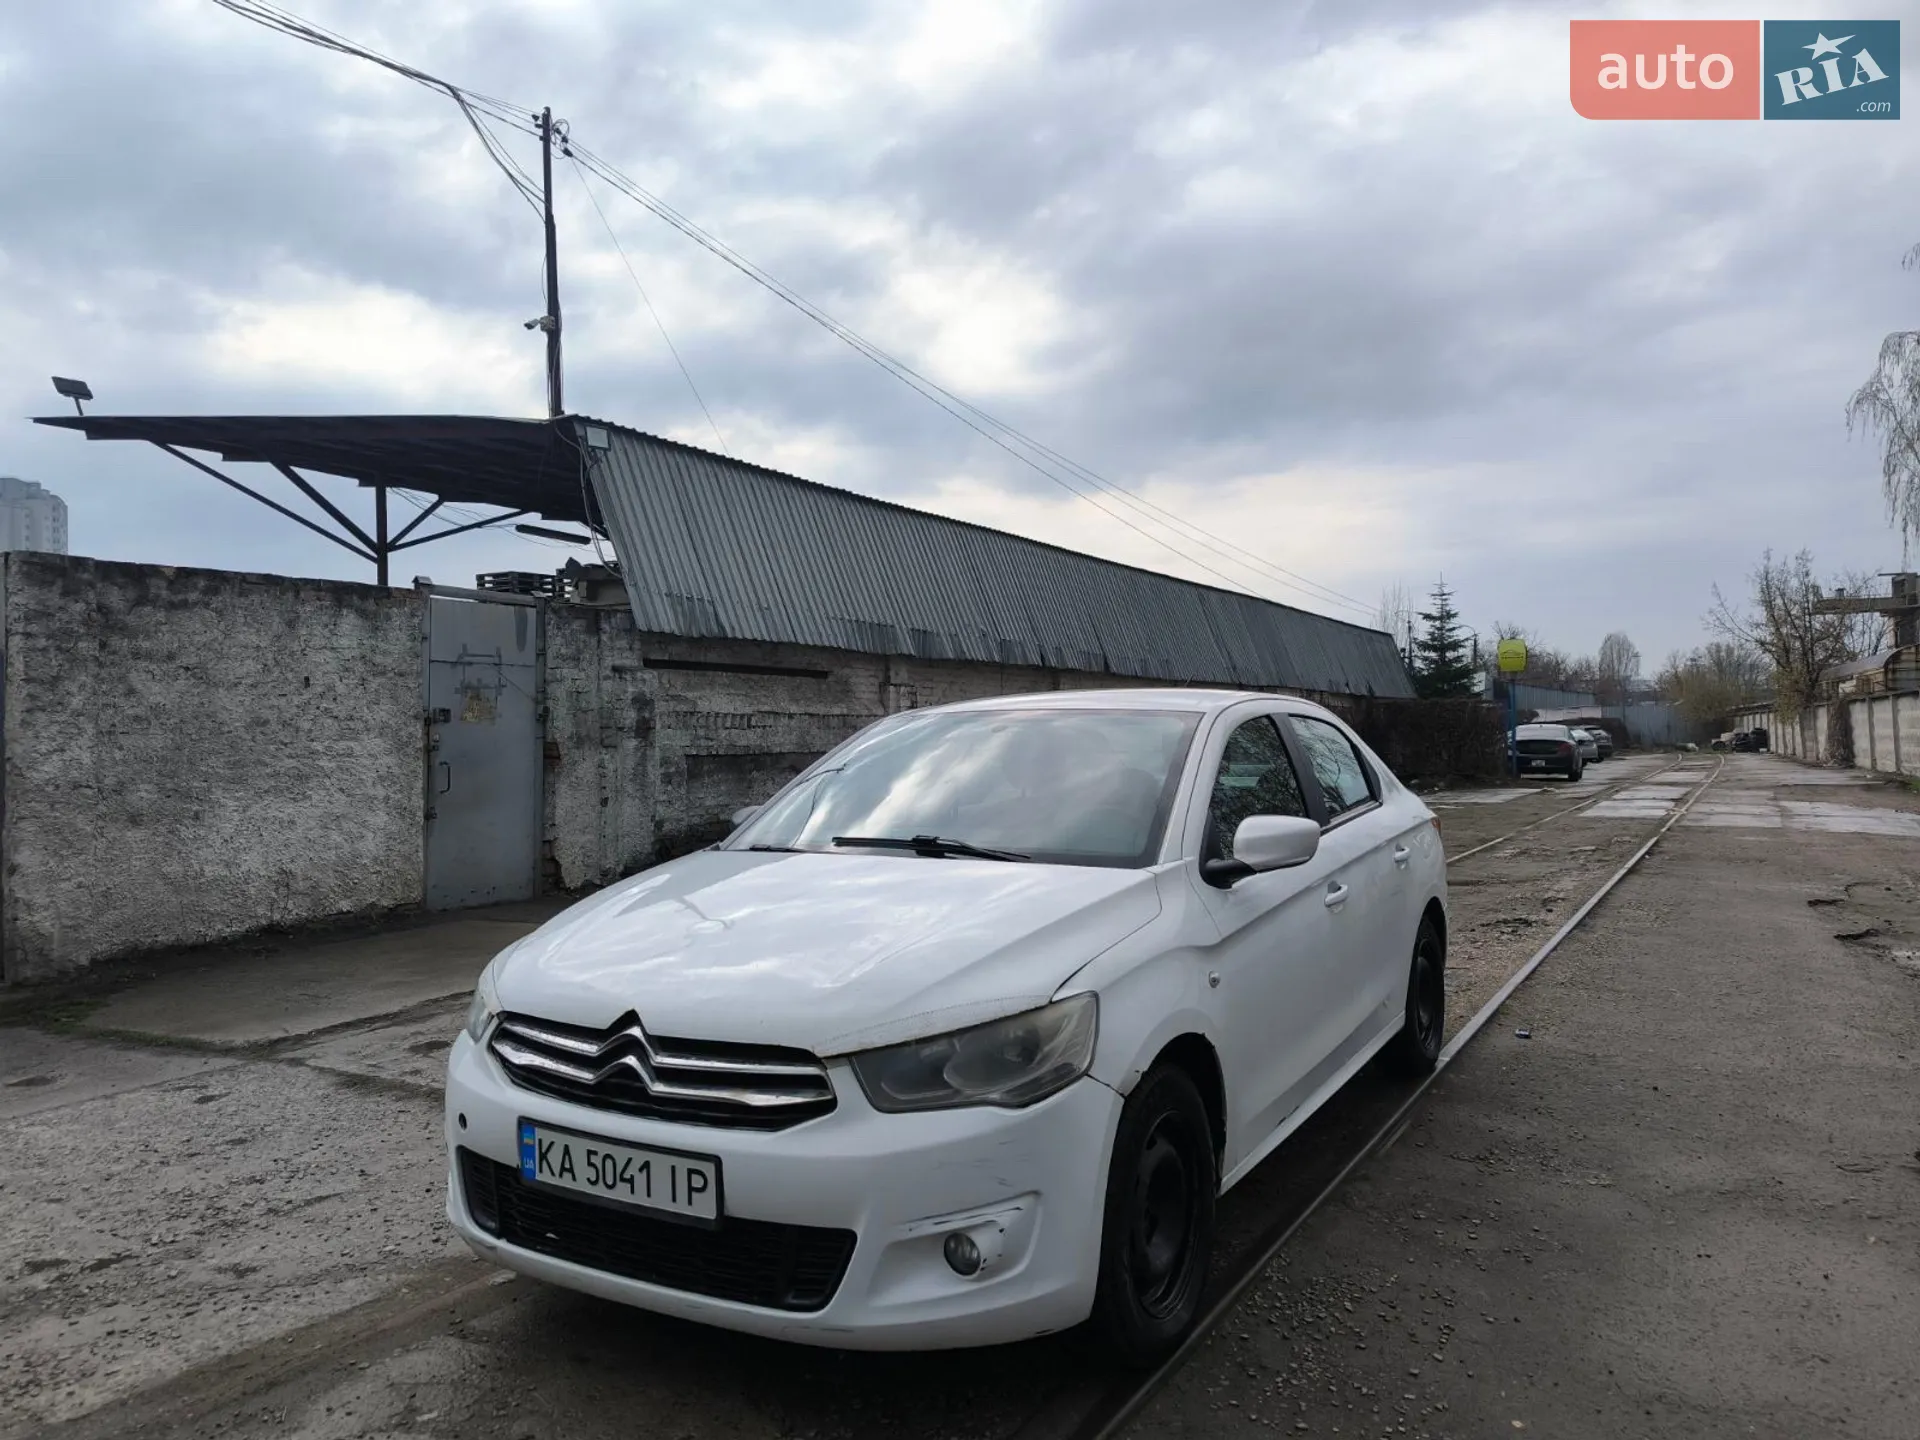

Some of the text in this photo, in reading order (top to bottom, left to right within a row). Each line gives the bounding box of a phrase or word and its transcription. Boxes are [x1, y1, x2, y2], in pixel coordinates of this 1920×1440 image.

[538, 1137, 709, 1207] KA 5041 IP
